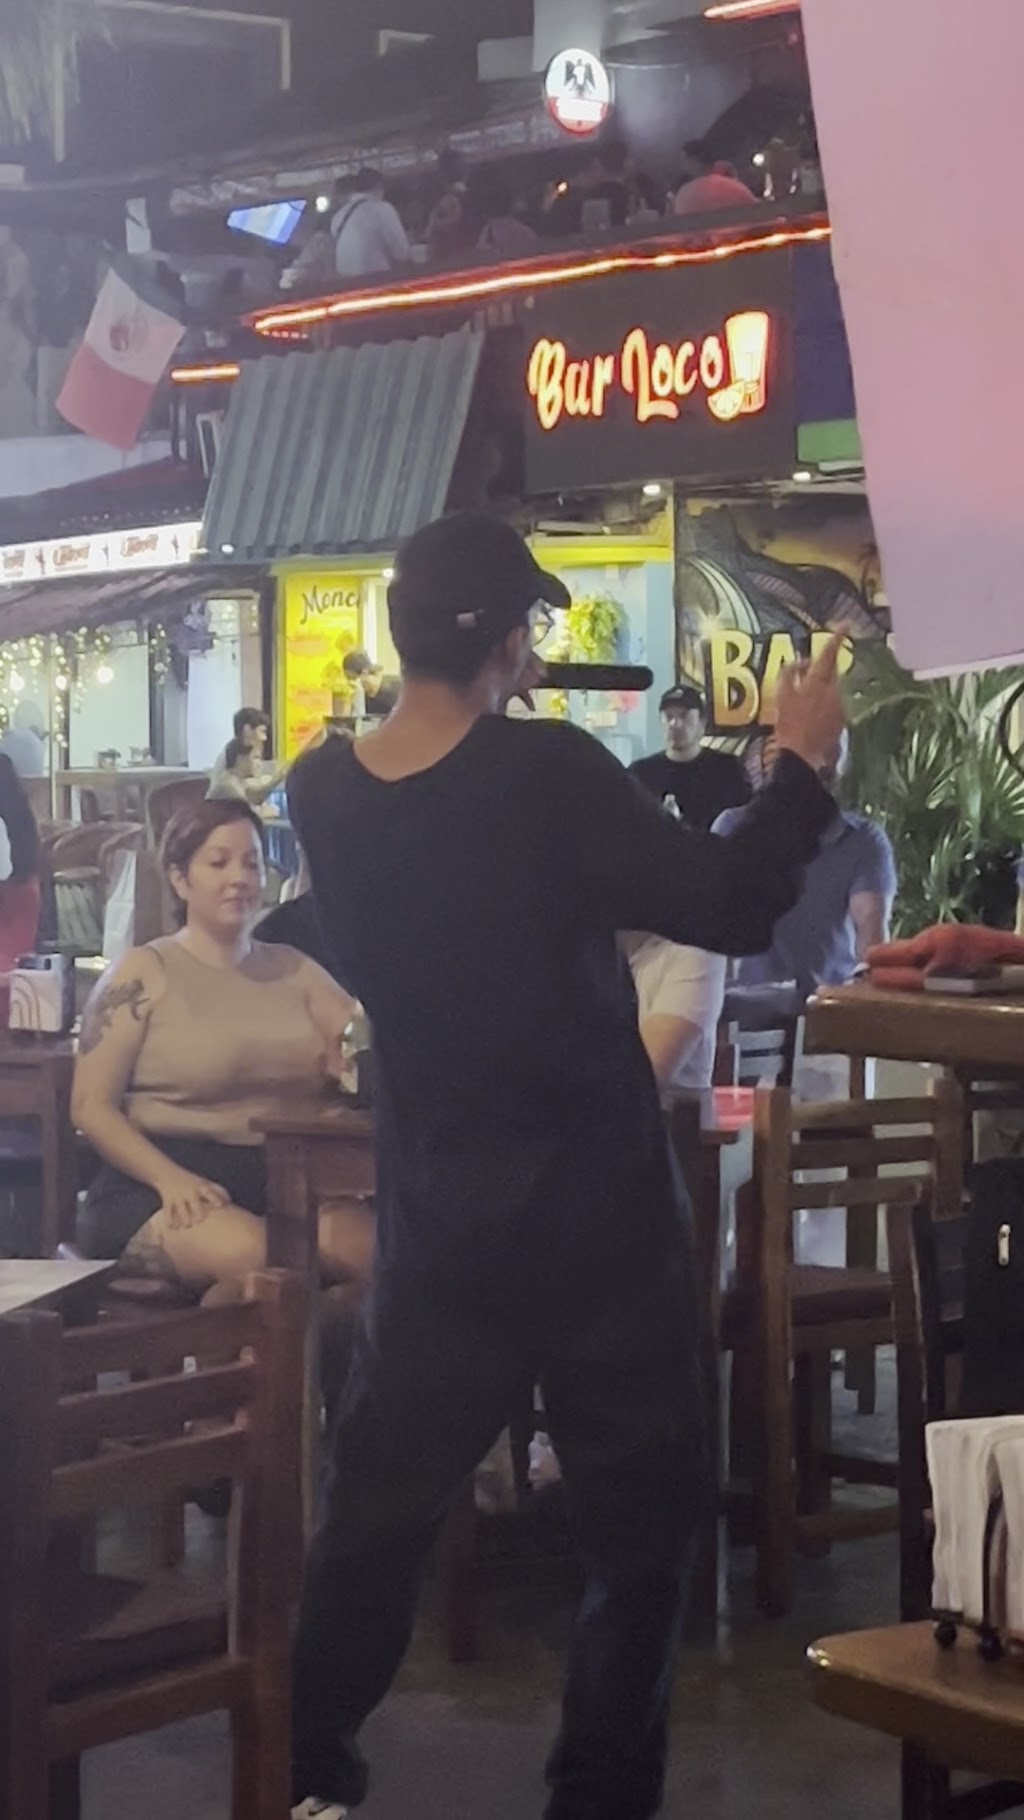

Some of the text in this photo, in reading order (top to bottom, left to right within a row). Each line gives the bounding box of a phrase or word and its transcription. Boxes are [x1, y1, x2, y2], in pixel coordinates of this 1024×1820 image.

[527, 327, 724, 430] Bar Loco
[299, 584, 361, 626] Monc
